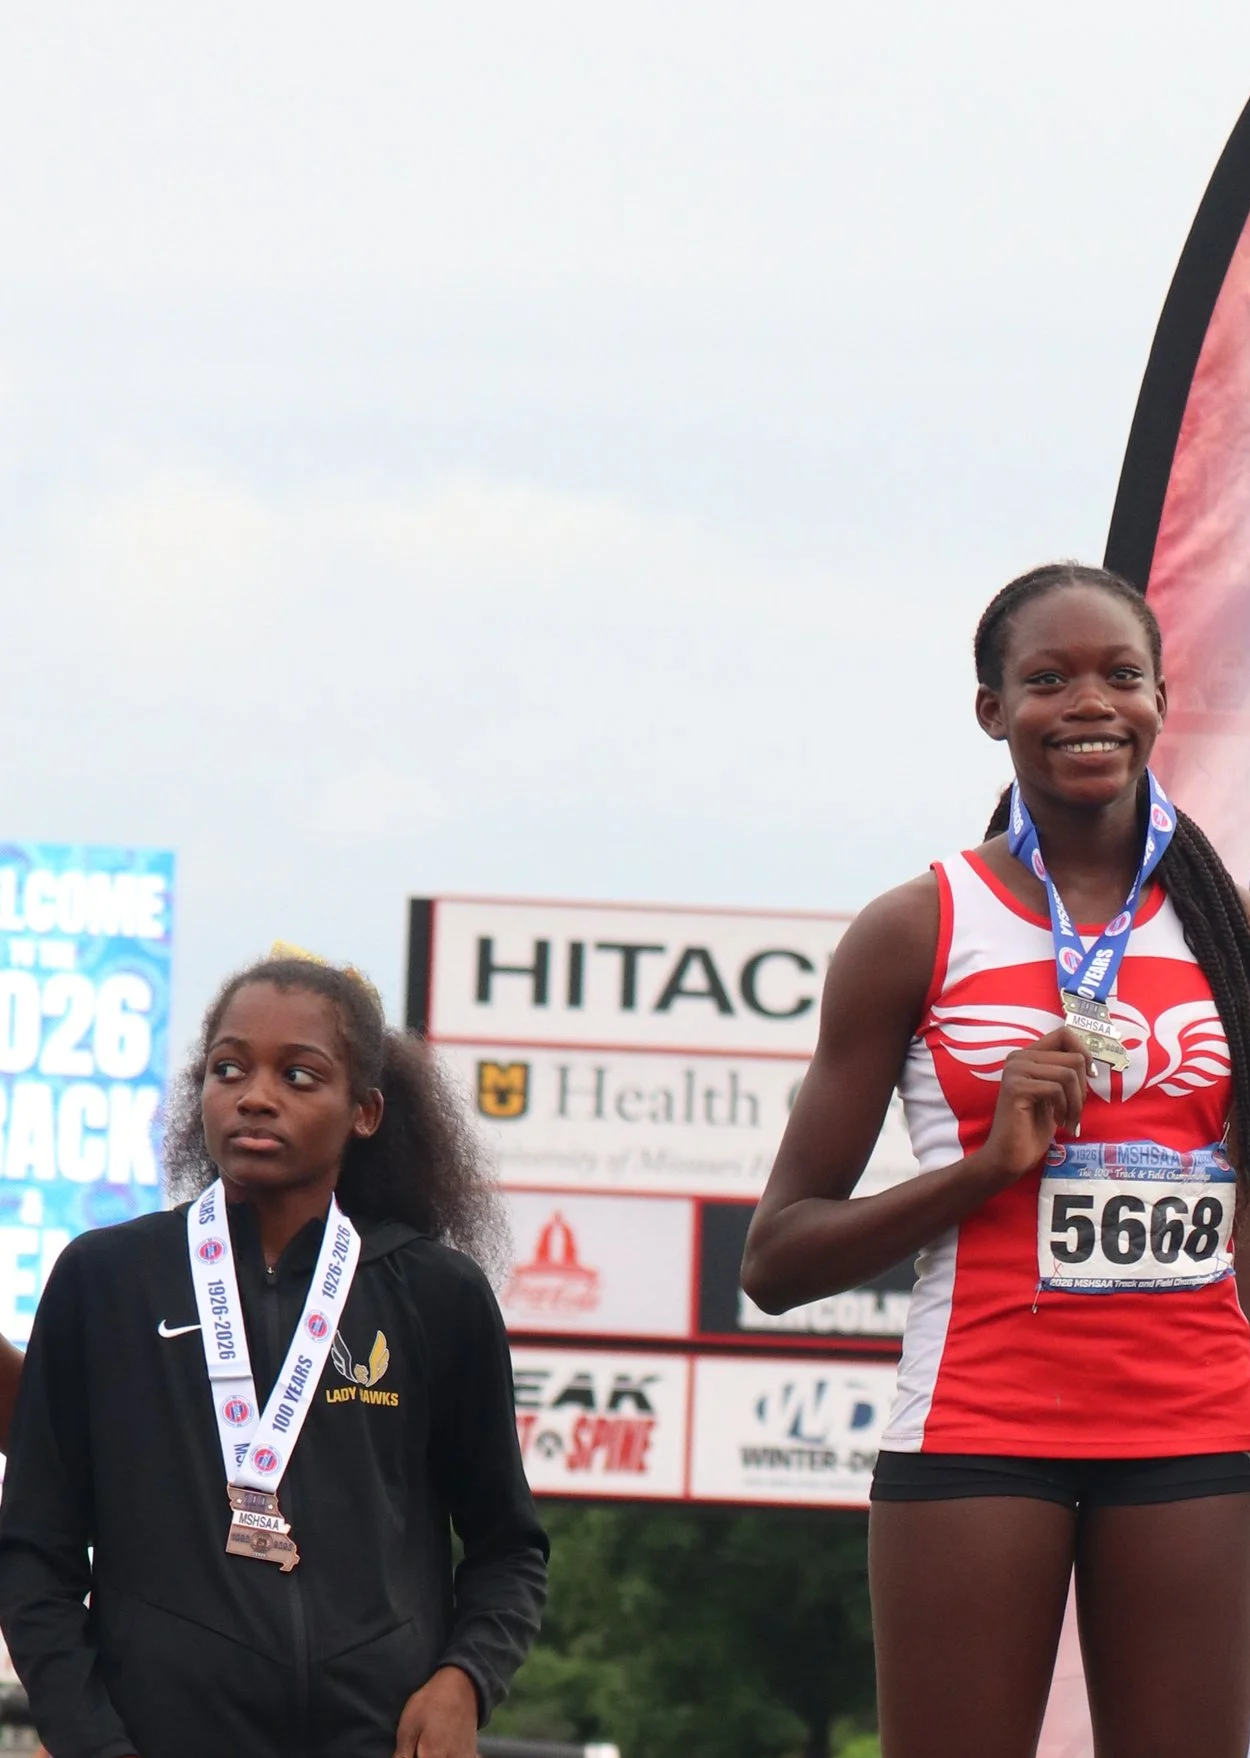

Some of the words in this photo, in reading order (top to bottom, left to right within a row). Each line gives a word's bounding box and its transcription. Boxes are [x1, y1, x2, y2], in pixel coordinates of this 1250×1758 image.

[474, 935, 833, 1020] HITAC
[1081, 948, 1114, 988] YEARS
[1071, 1015, 1112, 1036] MSHSAA
[555, 1062, 761, 1128] Health
[0, 1082, 159, 1186] ACK
[1076, 1149, 1097, 1161] 1926
[1117, 1145, 1180, 1166] MSHSAA
[1115, 1167, 1137, 1178] Track
[1050, 1194, 1224, 1265] 5668
[321, 1224, 351, 1300] 1926-2026
[1050, 1278, 1074, 1287] 2026
[1074, 1279, 1114, 1288] MSHSAA
[1114, 1279, 1137, 1288] Track
[1138, 1279, 1154, 1288] and
[1154, 1278, 1173, 1288] Field
[207, 1278, 236, 1360] 1926-2026
[272, 1402, 295, 1434] 100
[284, 1354, 313, 1404] YEARS
[326, 1387, 356, 1404] LADY
[238, 1512, 280, 1531] MSHSAA
